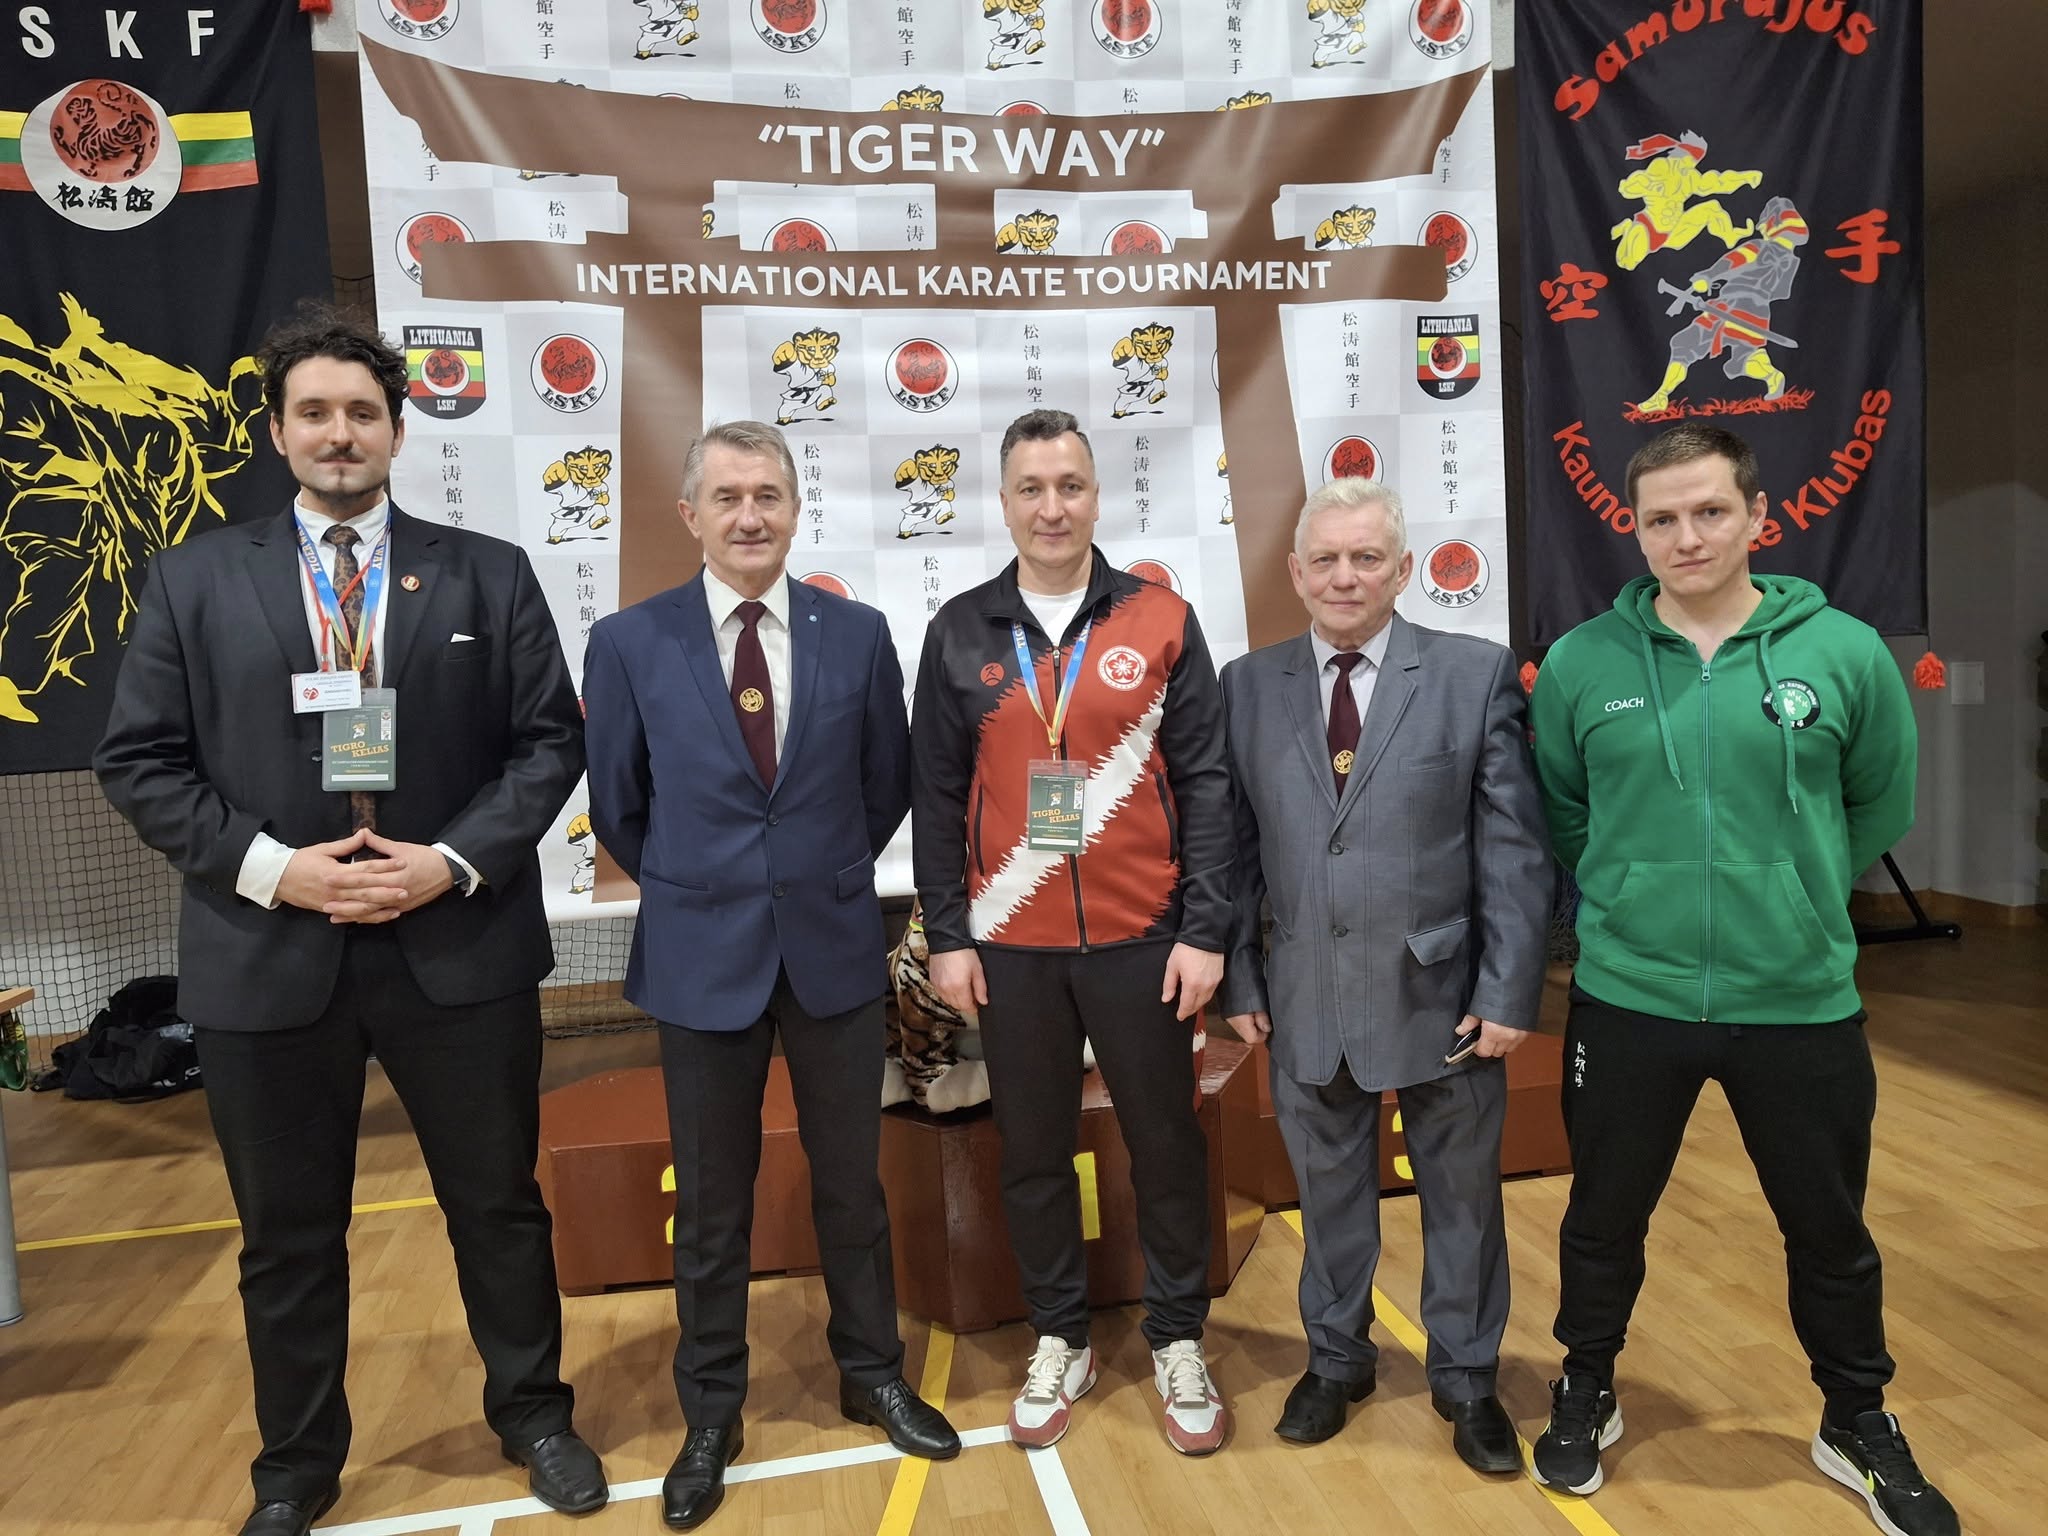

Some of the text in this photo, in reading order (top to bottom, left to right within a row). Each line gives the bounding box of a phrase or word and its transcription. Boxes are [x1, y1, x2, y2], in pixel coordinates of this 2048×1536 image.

[388, 11, 450, 39] LSKF
[760, 25, 817, 50] LSKF
[1100, 33, 1153, 56] LSKF
[1416, 34, 1467, 57] LSKF
[1825, 208, 1901, 284] 手
[576, 260, 1332, 297] INTERNATIONAL KARATE TOURNAMENT
[1421, 317, 1473, 334] LITHUANIA
[409, 328, 475, 347] LITHUANIA
[436, 399, 457, 411] LSKF
[541, 386, 598, 410] LSKF
[894, 386, 950, 410] LSKF
[1780, 387, 1893, 531] Klubas
[1552, 420, 1636, 535] Kauno
[1428, 583, 1481, 606] LSKF
[1604, 696, 1645, 712] COACH
[330, 740, 366, 753] TIGRO
[351, 744, 390, 758] KELIAS
[1031, 808, 1061, 818] TIGRO
[1048, 813, 1081, 823] KELIAS
[1073, 1151, 1101, 1240] 1
